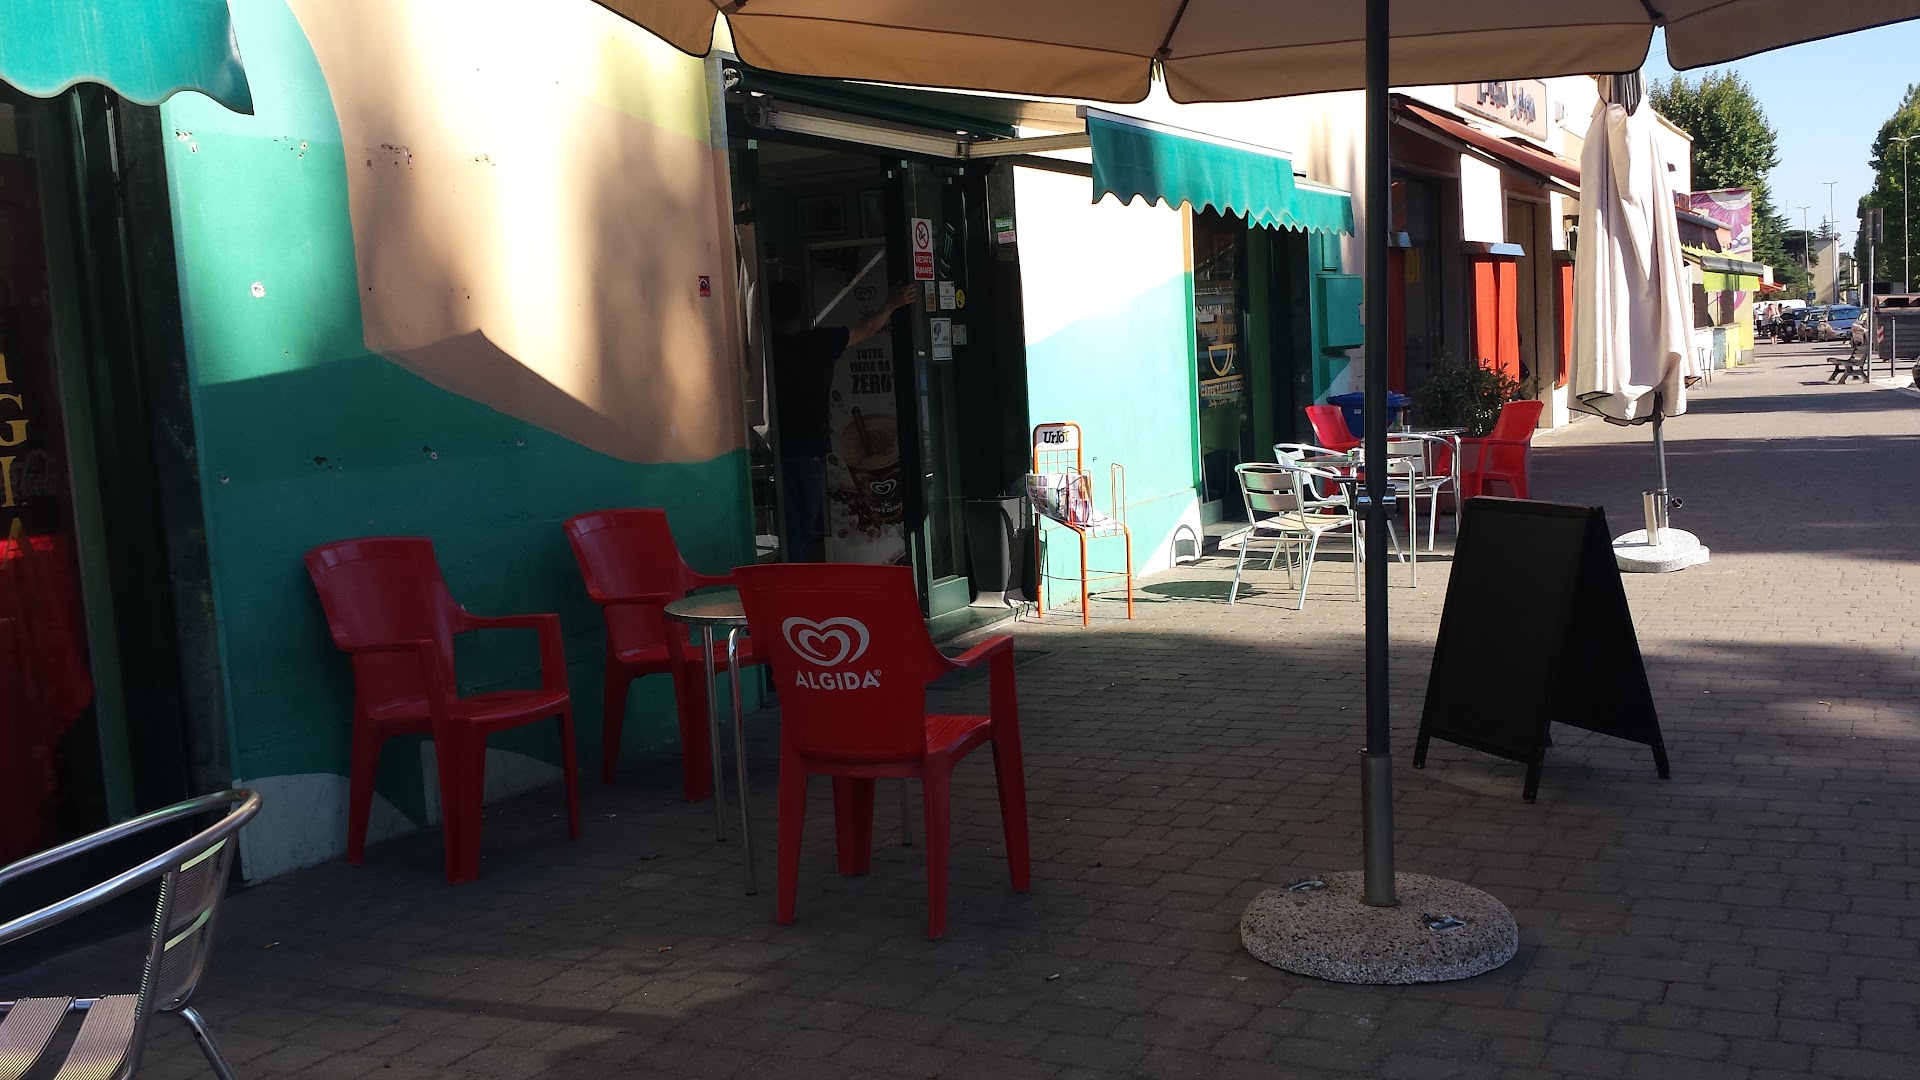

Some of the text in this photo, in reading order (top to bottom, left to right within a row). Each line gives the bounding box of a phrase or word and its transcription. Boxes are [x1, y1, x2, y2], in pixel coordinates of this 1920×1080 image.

[915, 256, 932, 264] VIETATO
[916, 266, 933, 275] FUMARE
[856, 348, 884, 360] TUTTO
[878, 360, 891, 371] DA
[796, 670, 880, 690] ALGIDA
